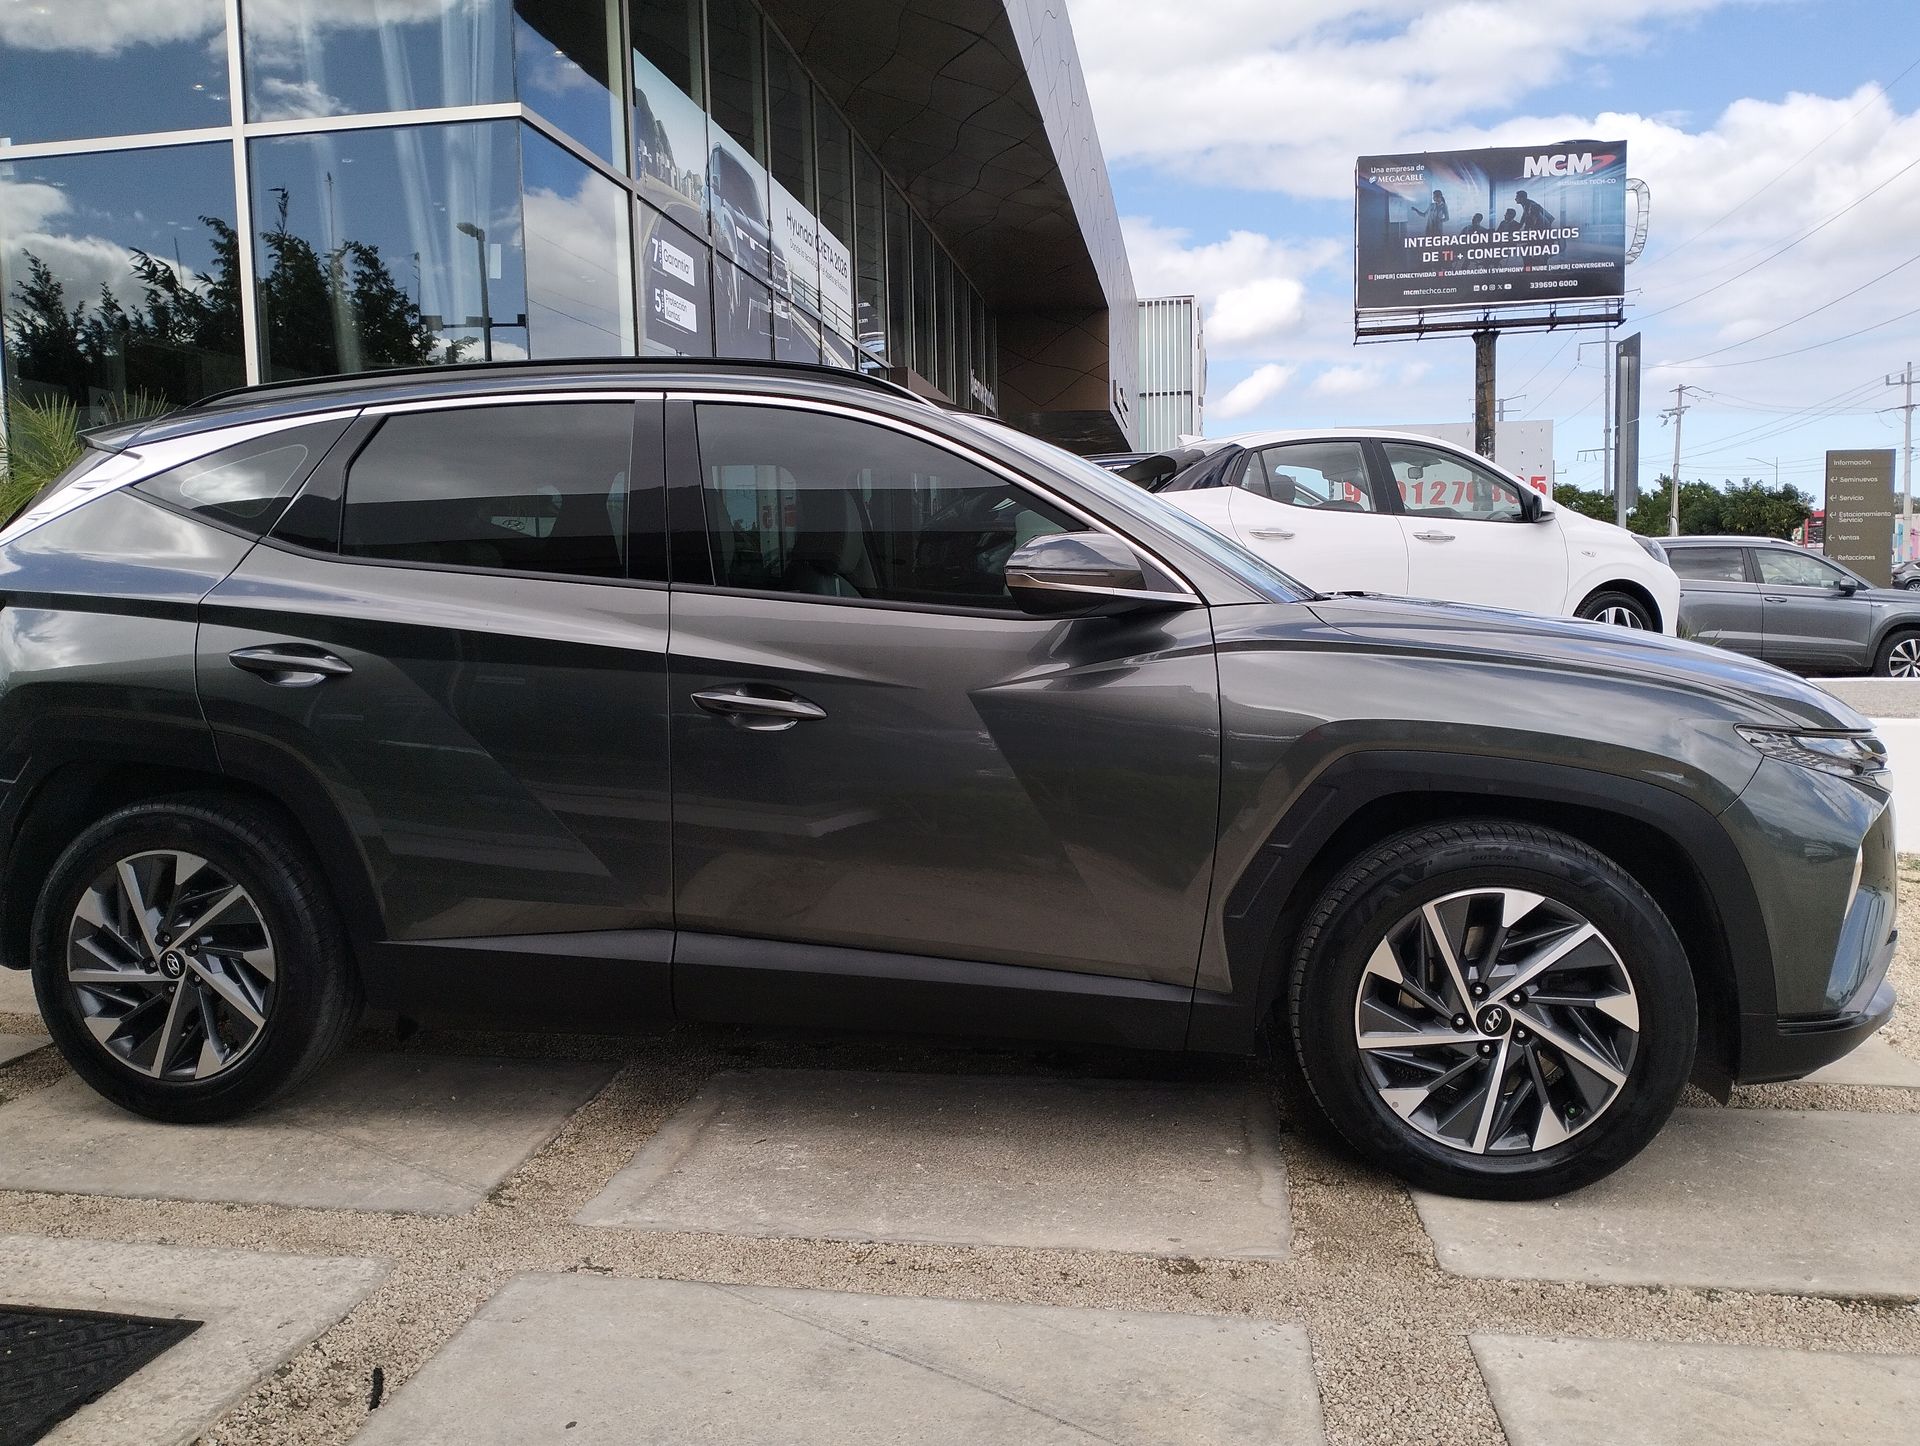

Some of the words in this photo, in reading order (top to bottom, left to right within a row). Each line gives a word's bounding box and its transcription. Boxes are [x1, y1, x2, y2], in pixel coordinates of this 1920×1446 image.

[1385, 165, 1415, 173] empresa
[1523, 153, 1593, 178] MCM
[1377, 174, 1424, 183] MEGACABLE
[785, 207, 815, 249] Hyundai
[833, 251, 848, 279] 2026
[1404, 231, 1489, 249] INTEGRACIÓN
[1492, 231, 1509, 243] DE
[1512, 227, 1579, 242] SERVICIOS
[651, 237, 659, 262] 7
[1422, 251, 1439, 263] DE
[1442, 250, 1454, 262] TI
[1467, 244, 1560, 260] CONECTIVIDAD
[1444, 269, 1487, 277] COLABORACIÓN
[1491, 266, 1524, 274] SYMPHONY
[1403, 287, 1457, 296] mcmtechco.com
[1530, 281, 1558, 289] 339690
[654, 287, 662, 313] 5
[1839, 510, 1892, 518] Estacionamiento
